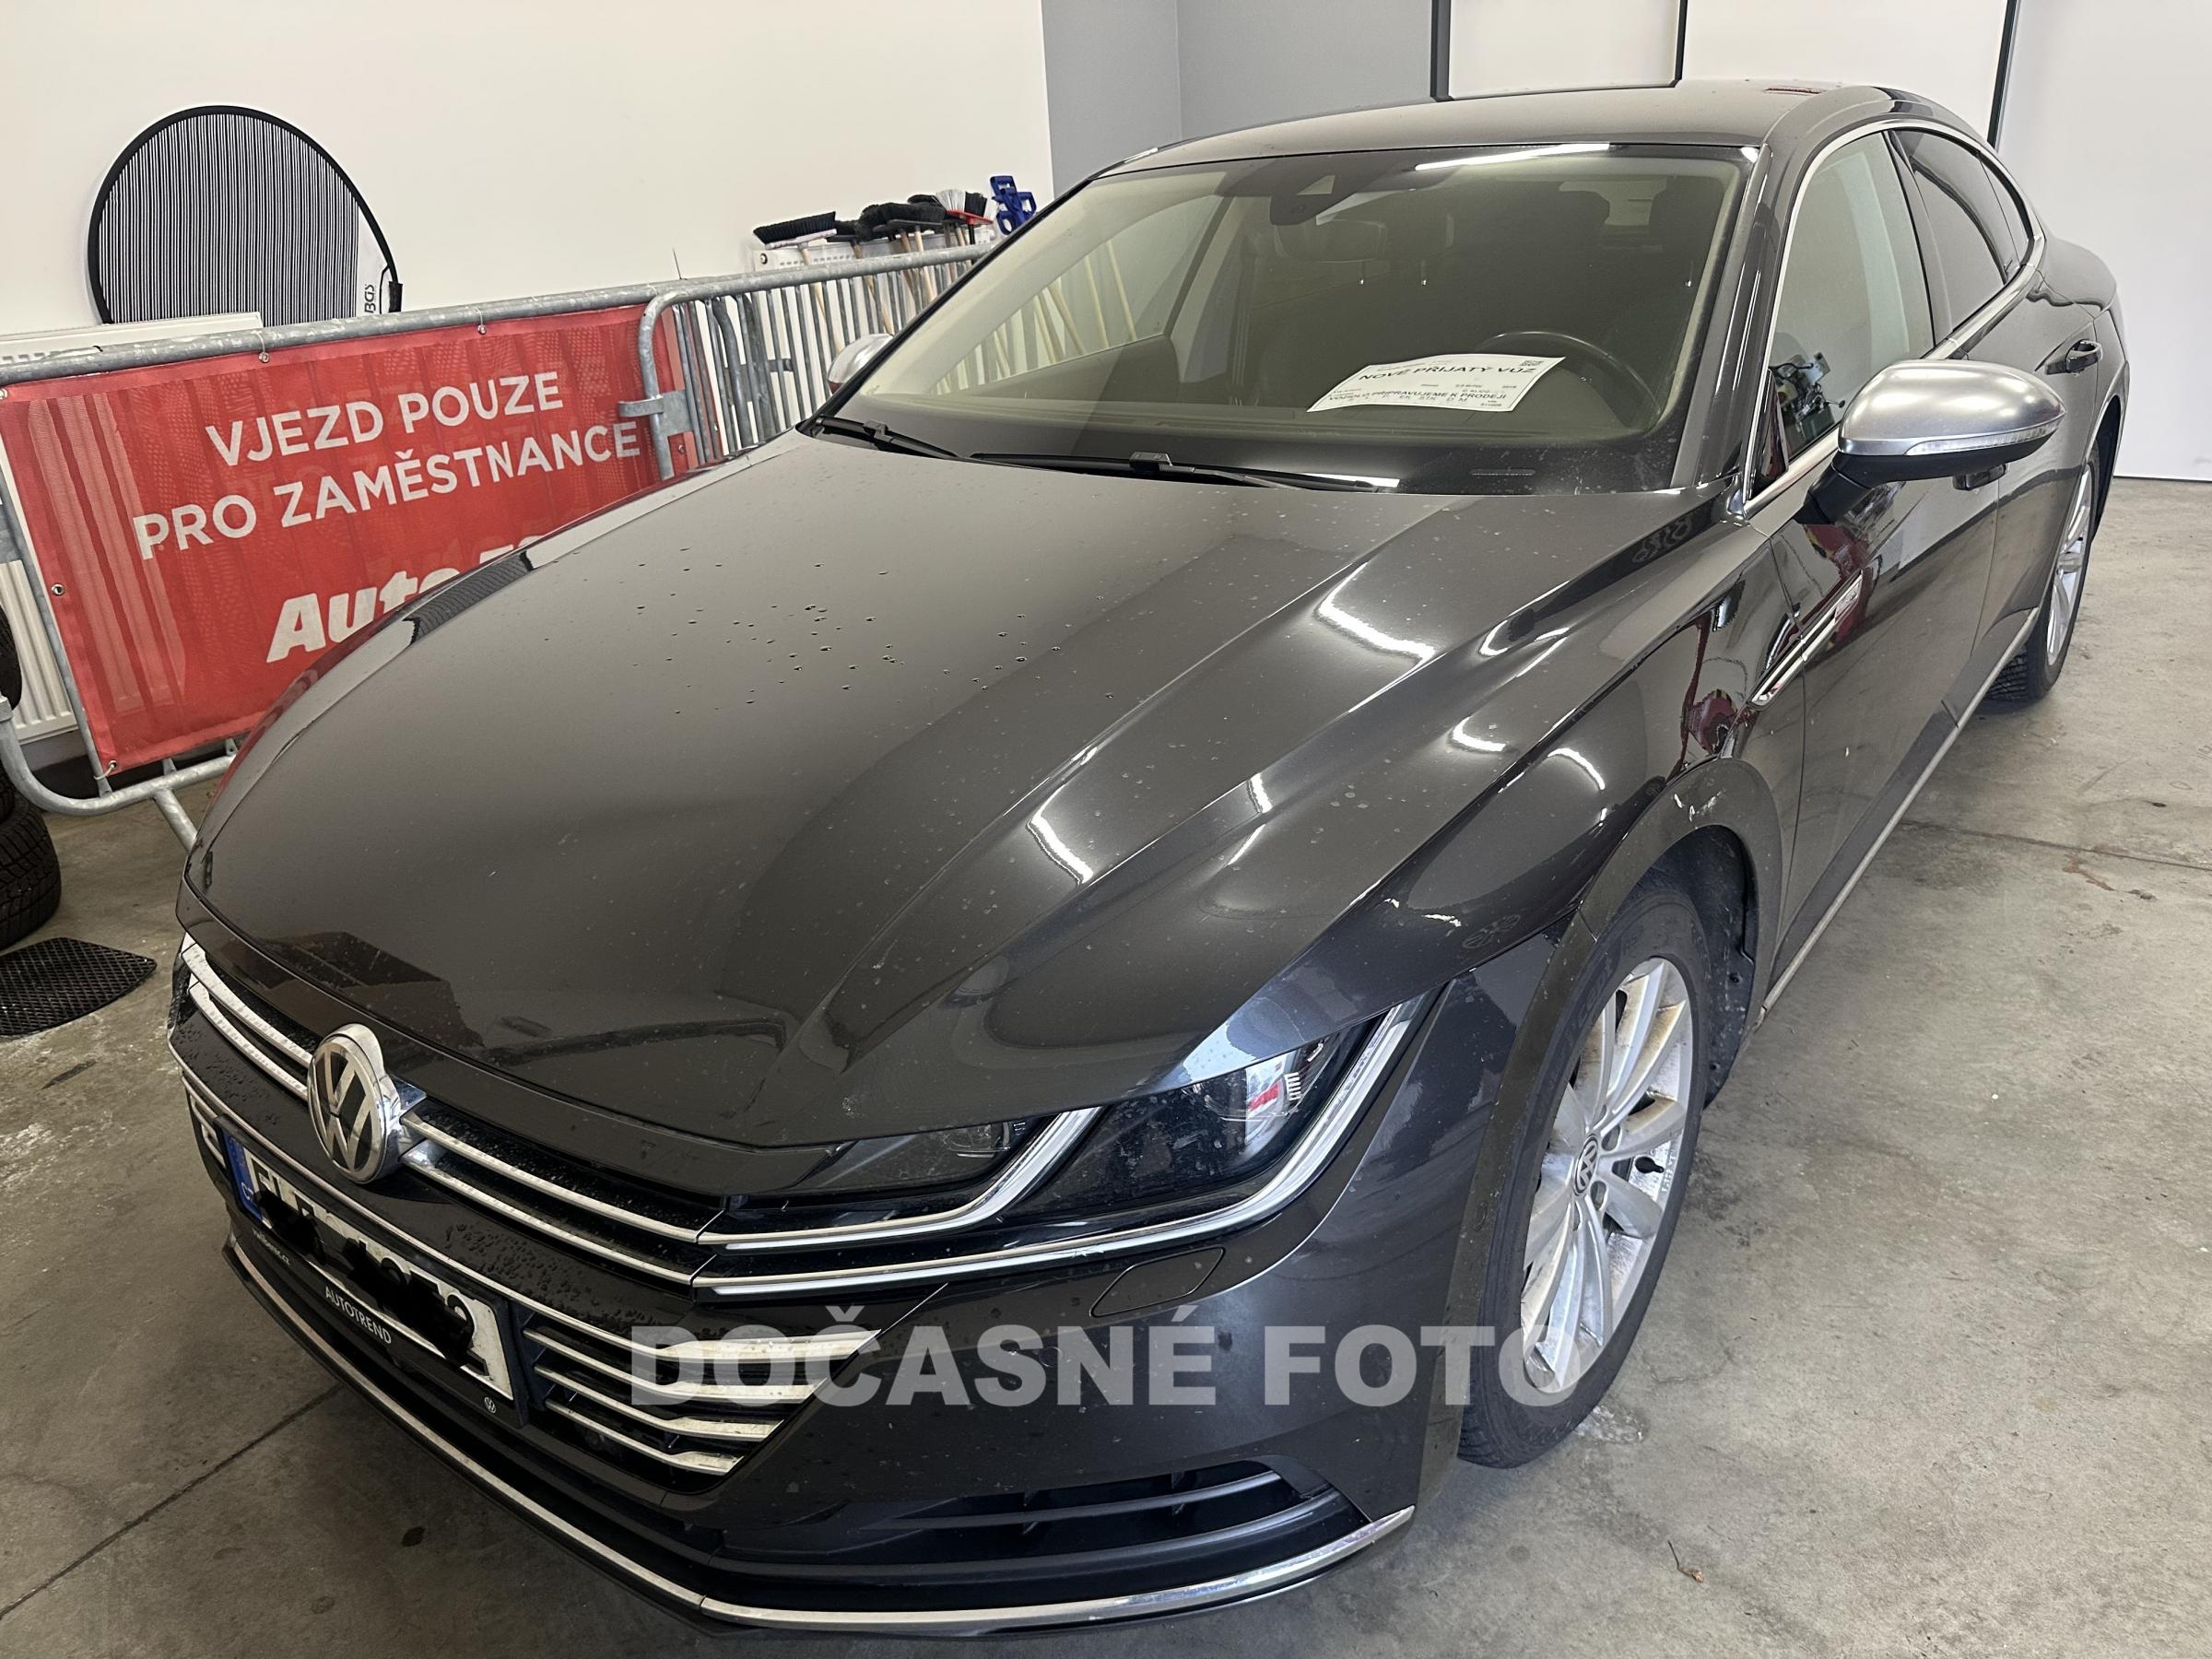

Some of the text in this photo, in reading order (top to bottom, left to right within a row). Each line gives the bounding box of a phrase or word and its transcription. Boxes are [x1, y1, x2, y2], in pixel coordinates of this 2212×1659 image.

[206, 371, 563, 466] VJEZD POUZE
[133, 421, 641, 560] PRO ZAMĚSTNANCE
[325, 1286, 392, 1344] AUTOTREND
